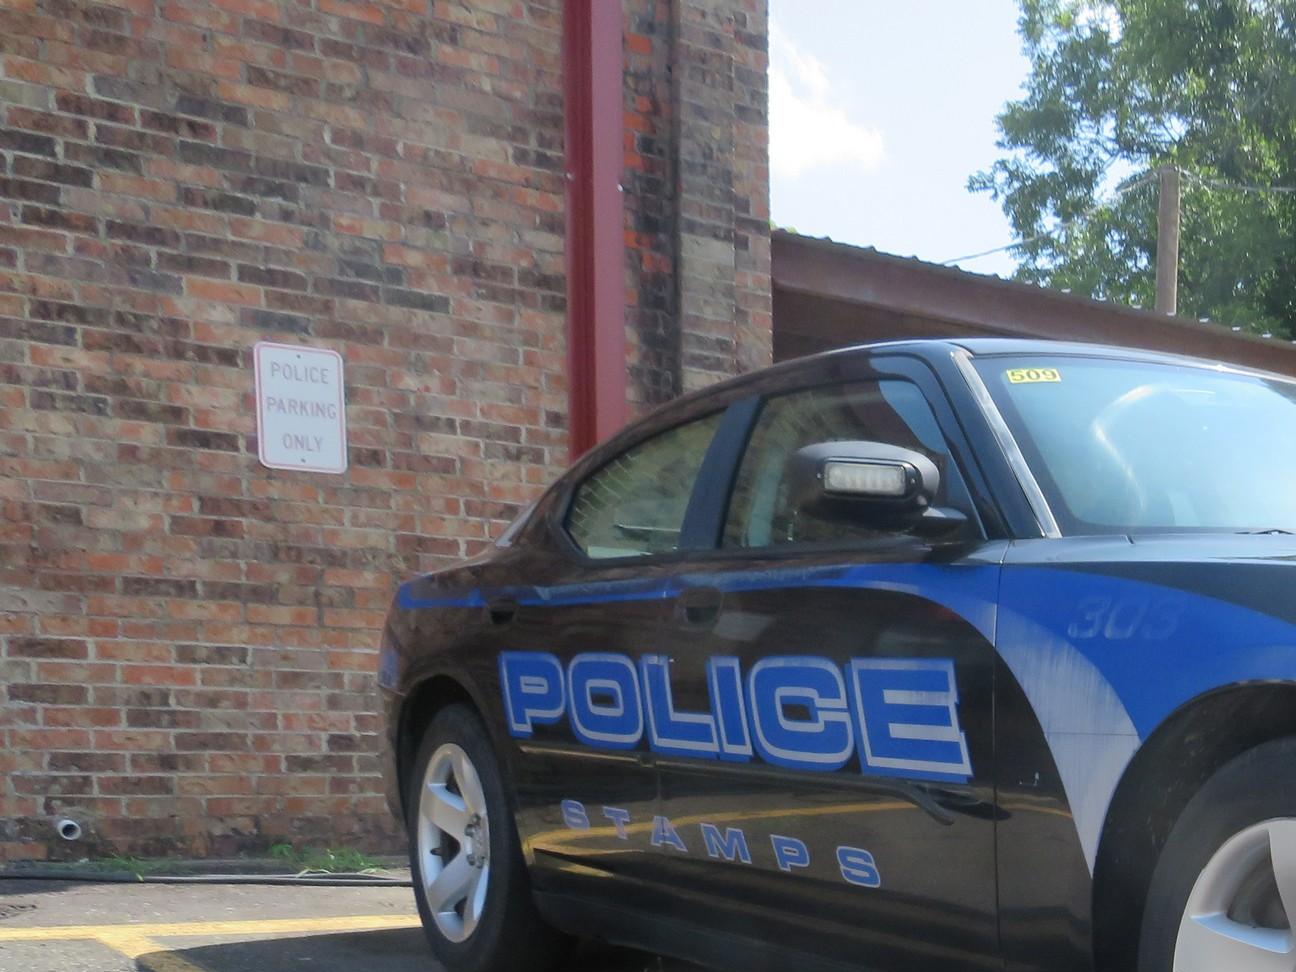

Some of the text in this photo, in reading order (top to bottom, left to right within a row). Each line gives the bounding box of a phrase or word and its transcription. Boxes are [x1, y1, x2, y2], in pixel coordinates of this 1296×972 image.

[270, 361, 329, 384] POLICE
[1010, 369, 1057, 382] 509
[266, 396, 337, 420] PARKING
[282, 433, 323, 452] ONLY
[1067, 594, 1186, 640] 303
[498, 650, 973, 783] POLICE
[559, 799, 881, 888] STAMPS
